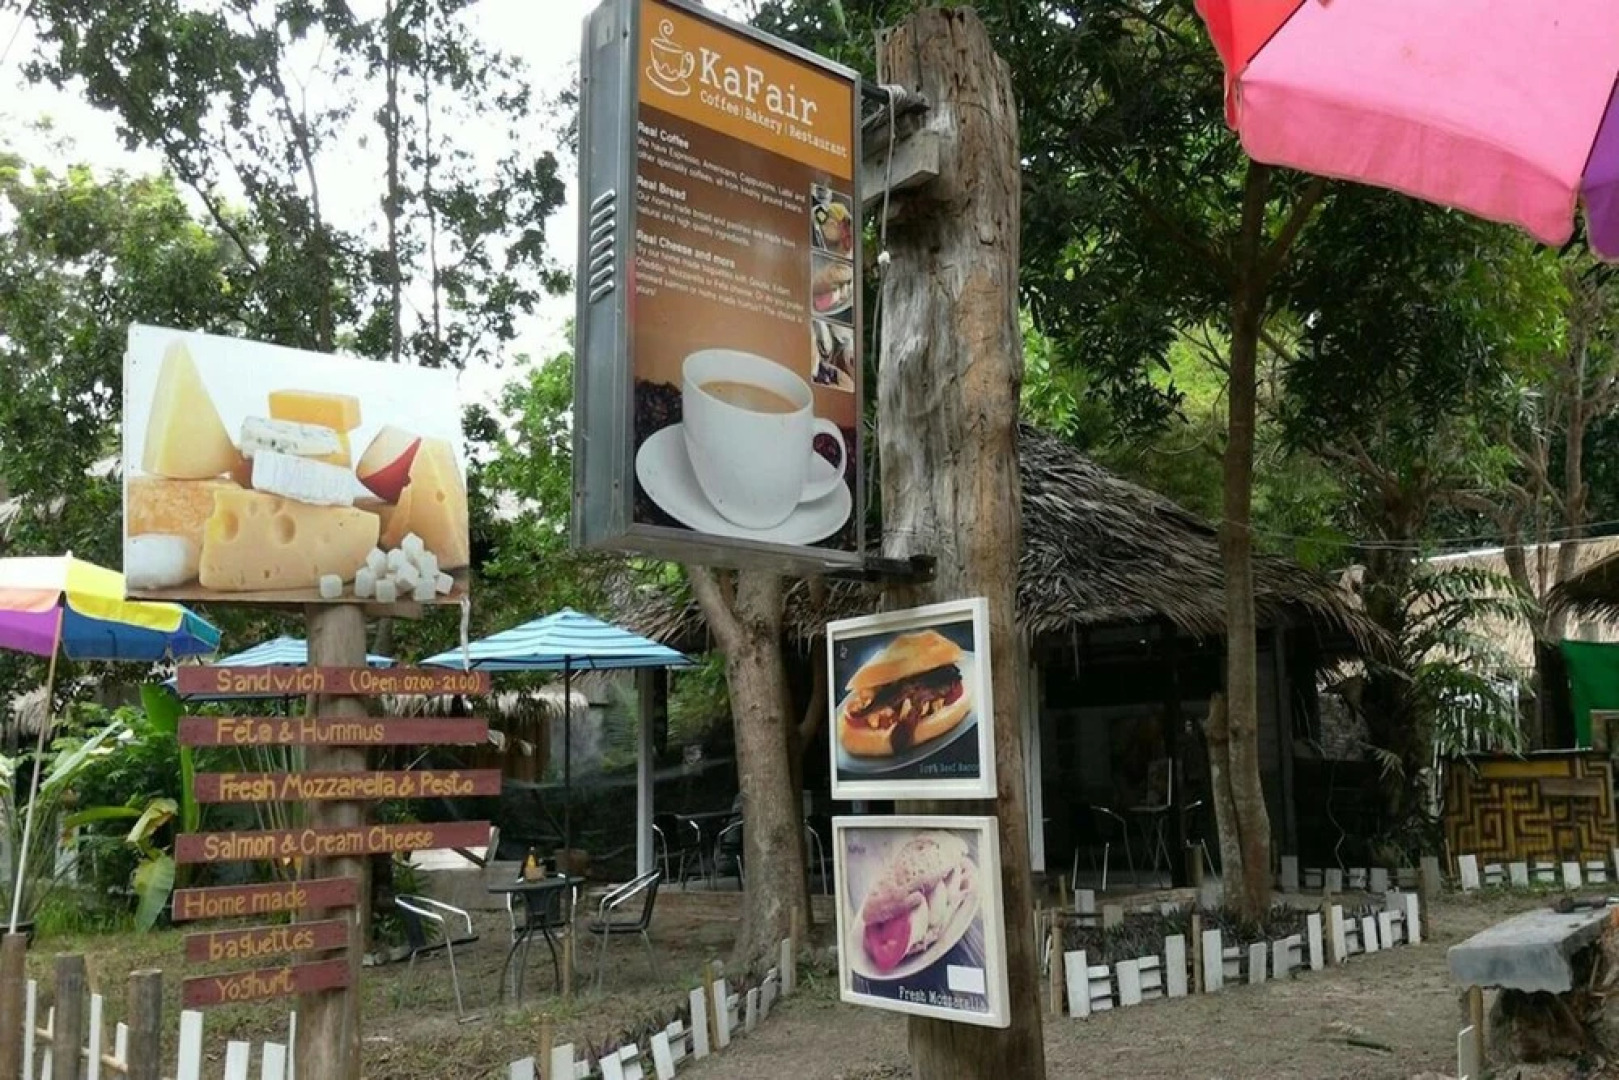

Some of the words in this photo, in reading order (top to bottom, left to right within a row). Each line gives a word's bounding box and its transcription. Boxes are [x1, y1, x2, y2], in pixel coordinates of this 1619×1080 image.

[700, 47, 818, 126] KaFair
[637, 121, 657, 137] Real
[660, 129, 689, 149] Coffee
[700, 90, 739, 116] Coffee
[745, 106, 783, 135] Bakery
[789, 124, 848, 158] Restaurant
[637, 175, 657, 190] Real
[659, 182, 686, 201] Bread
[636, 229, 657, 244] Real
[659, 237, 692, 256] Cheese
[694, 249, 711, 261] and
[713, 255, 735, 268] more
[216, 668, 324, 692] Sandwich
[216, 719, 273, 743] Feta
[280, 722, 294, 742] &
[300, 718, 384, 742] Hummus
[219, 774, 276, 800] Fresh
[280, 774, 395, 798] Mozzarella
[399, 776, 415, 796] &
[420, 771, 474, 793] Pesto
[204, 833, 276, 860] Salmon
[281, 834, 298, 852] &
[300, 828, 364, 856] Cream
[368, 827, 434, 850] Cheese
[184, 893, 246, 918] Home
[252, 882, 308, 912] made
[209, 928, 315, 961] baguettes
[216, 967, 294, 1000] Yoghurt
[899, 985, 926, 1002] Fresh
